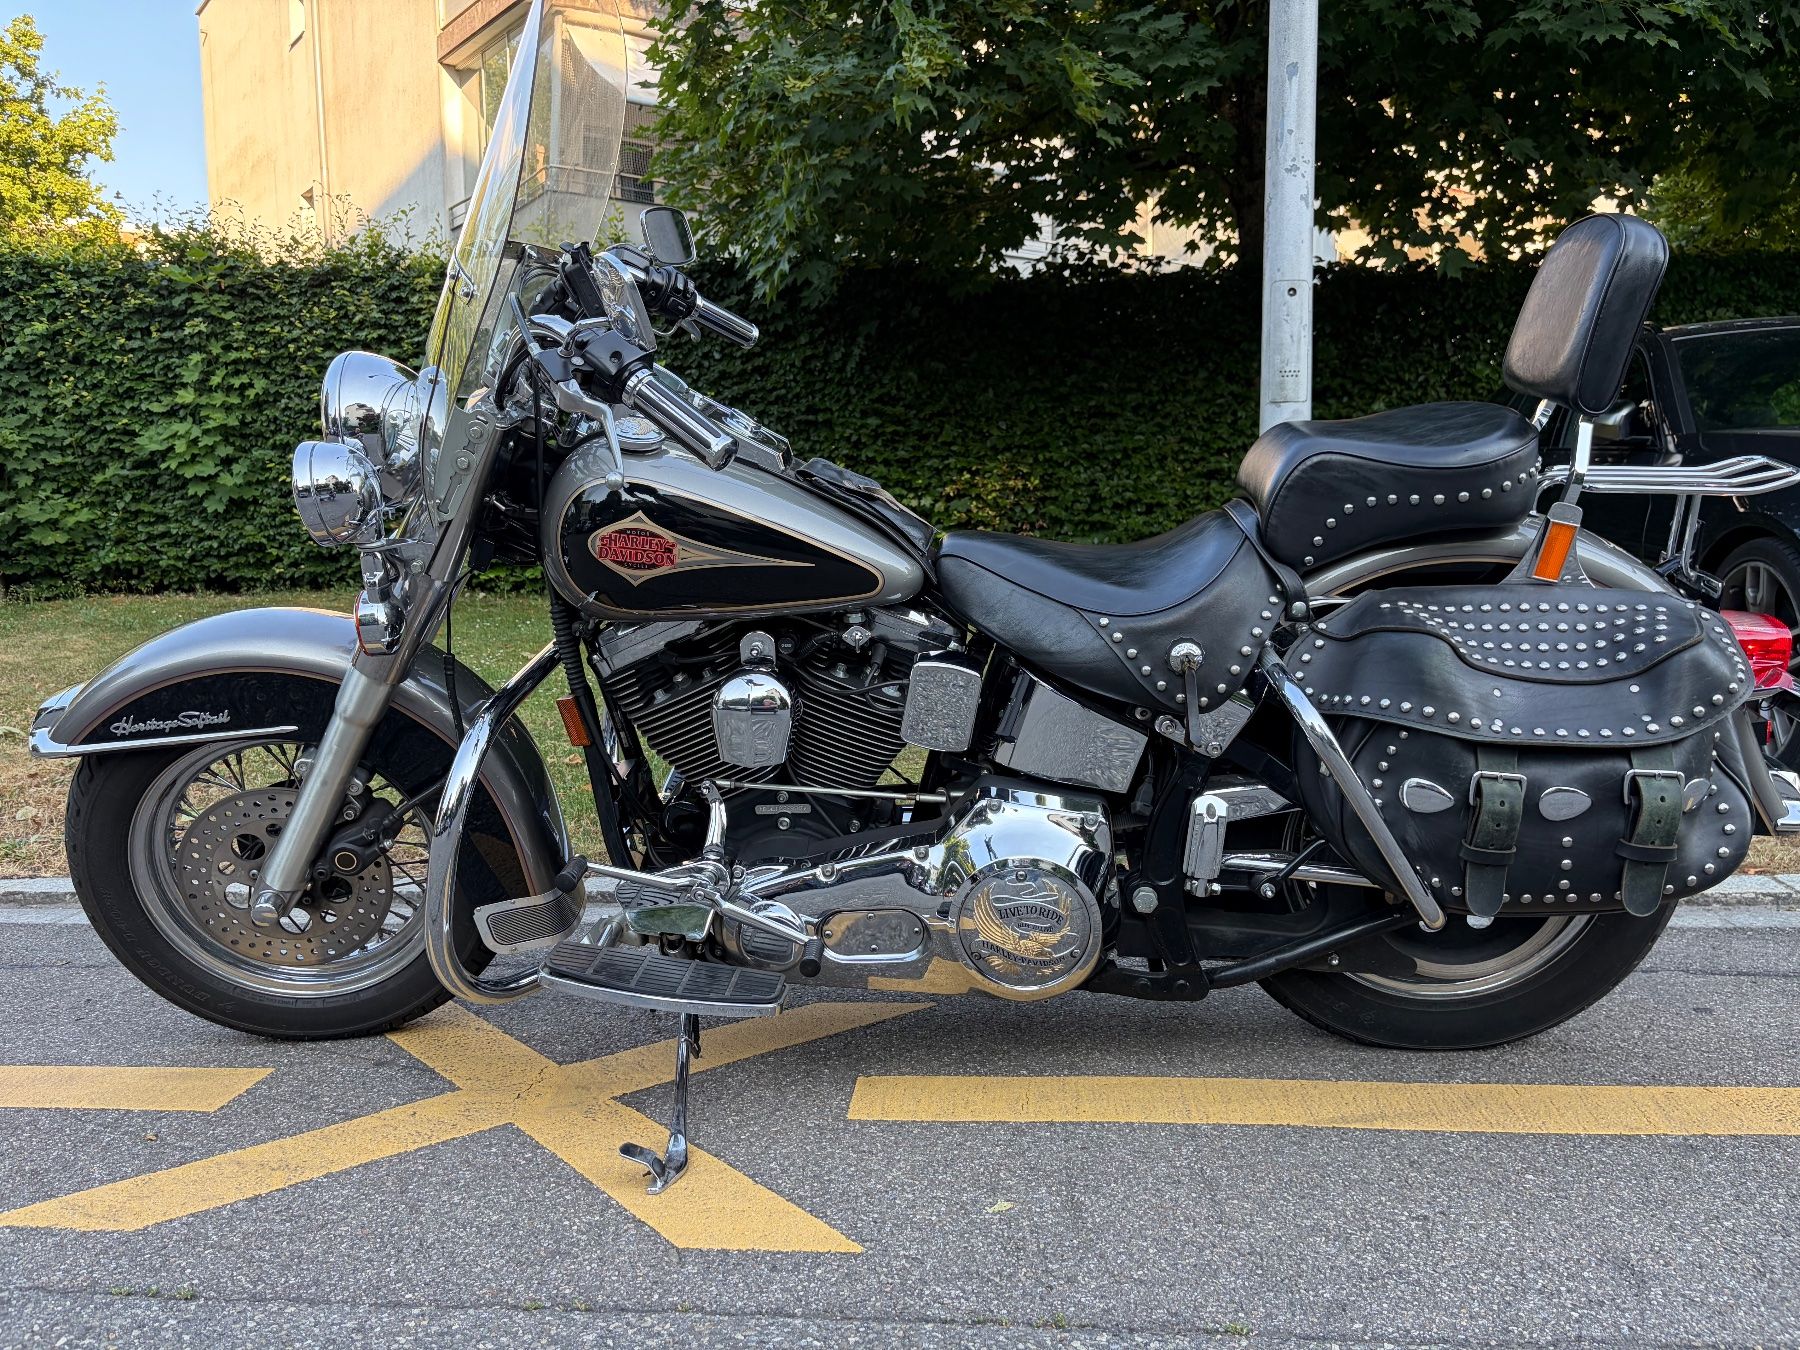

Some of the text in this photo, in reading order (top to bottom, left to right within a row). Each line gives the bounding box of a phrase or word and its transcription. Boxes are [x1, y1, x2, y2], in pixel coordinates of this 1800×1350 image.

[598, 533, 677, 551] HARLEY
[597, 545, 677, 568] DAVIDSON
[110, 710, 231, 737] Heritage Softail
[999, 905, 1065, 925] LIVE TO RIDE
[983, 941, 1065, 967] HARLEY-DAVIDSON
